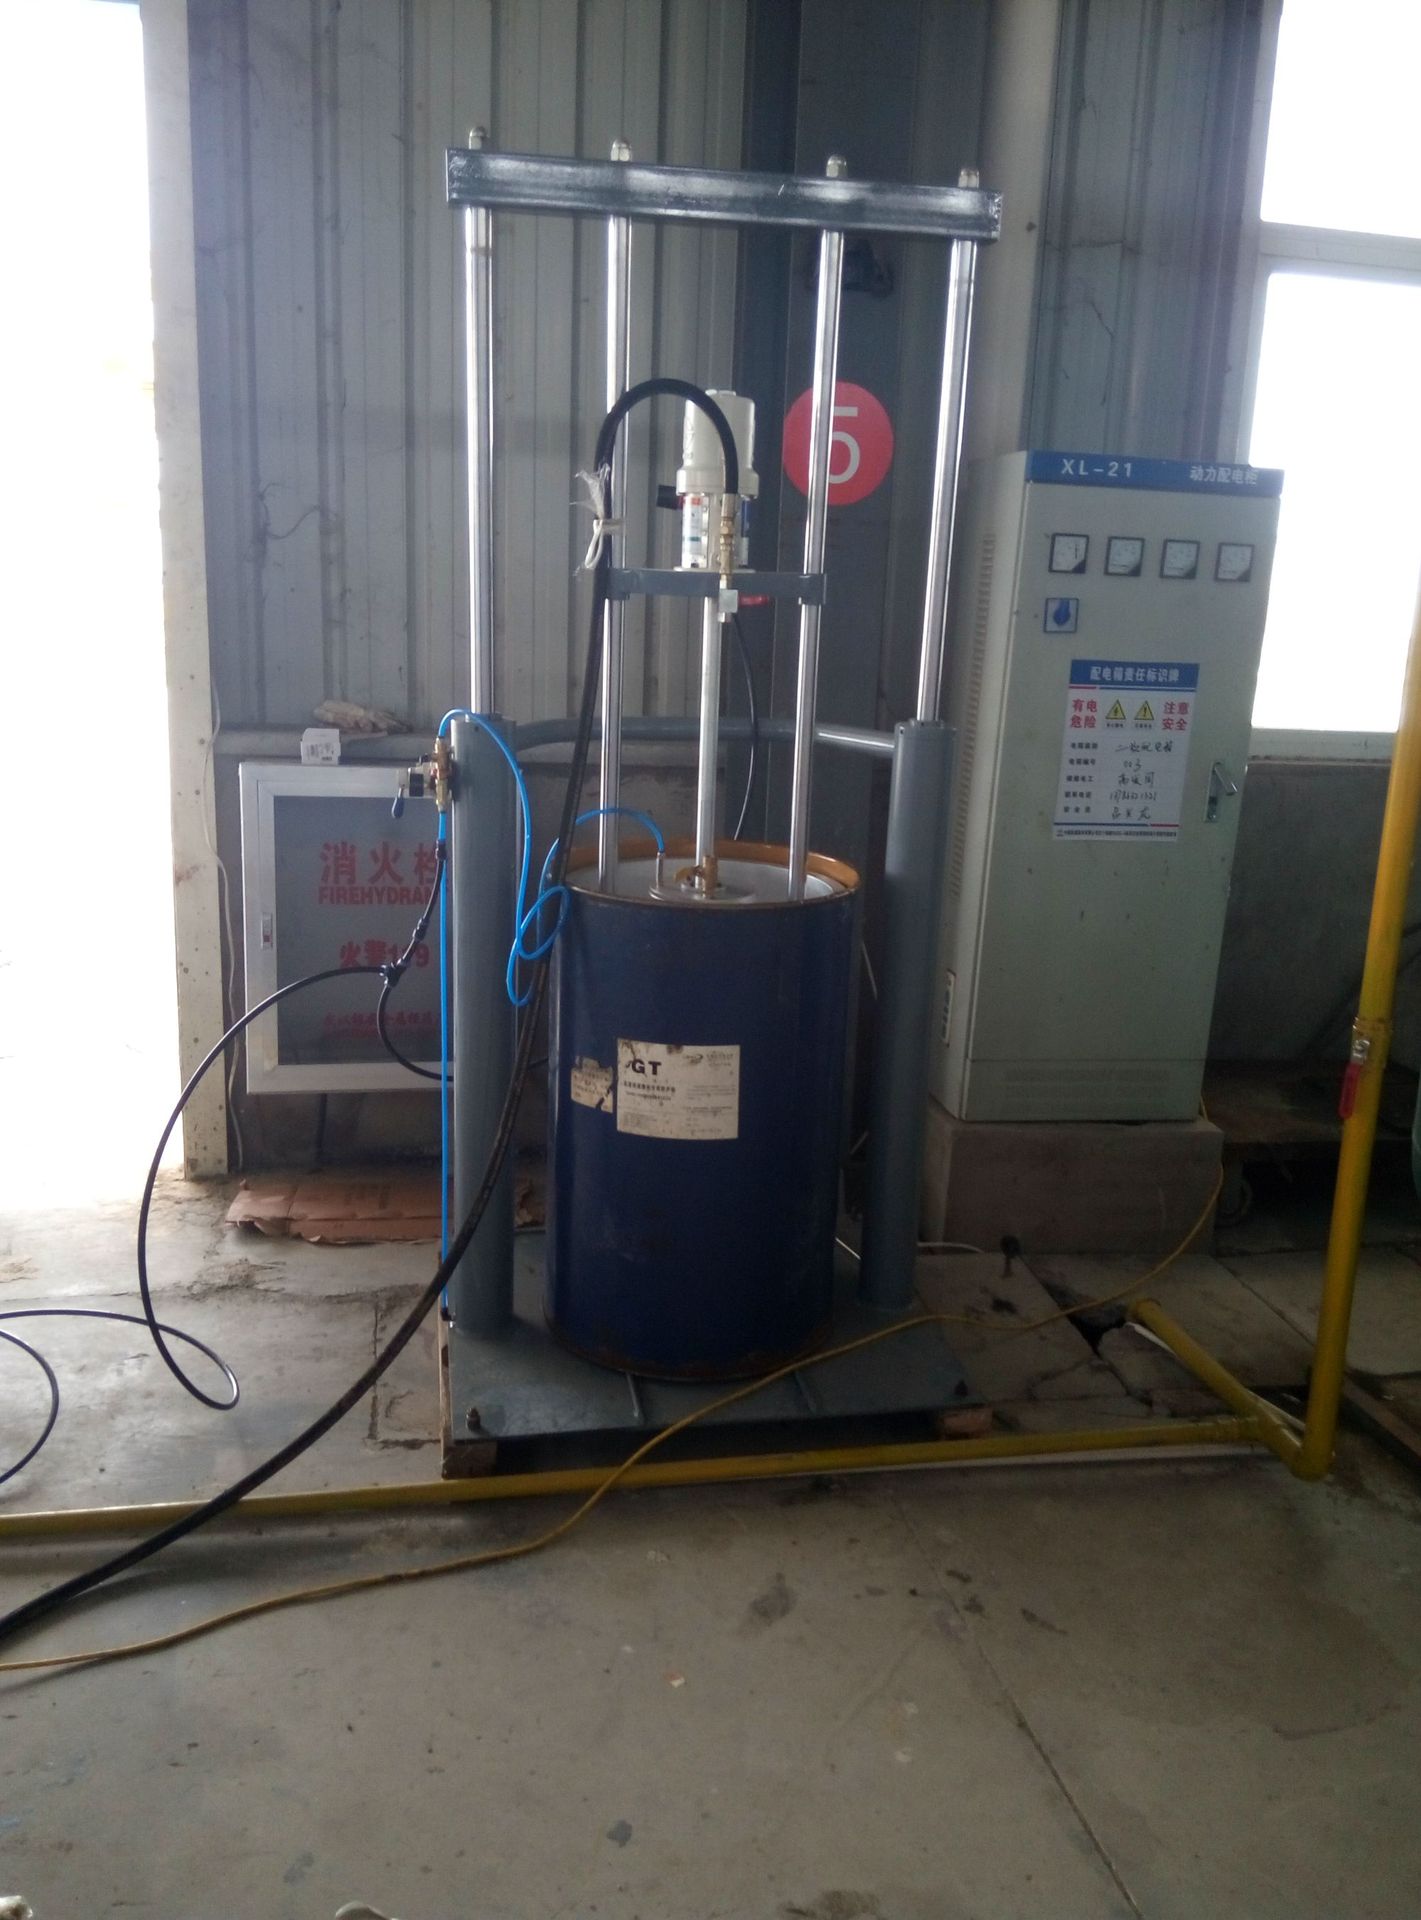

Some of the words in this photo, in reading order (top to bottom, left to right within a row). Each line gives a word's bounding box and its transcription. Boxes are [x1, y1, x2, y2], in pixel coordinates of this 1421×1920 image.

[827, 405, 861, 485] 5
[1061, 458, 1132, 478] XL-21
[1189, 465, 1259, 485] 动力配电柜
[1071, 698, 1097, 713] 有电
[1163, 701, 1189, 715] 注意
[1070, 715, 1097, 729] 危险
[1161, 718, 1188, 731] 安全
[320, 840, 446, 884] 消火栓
